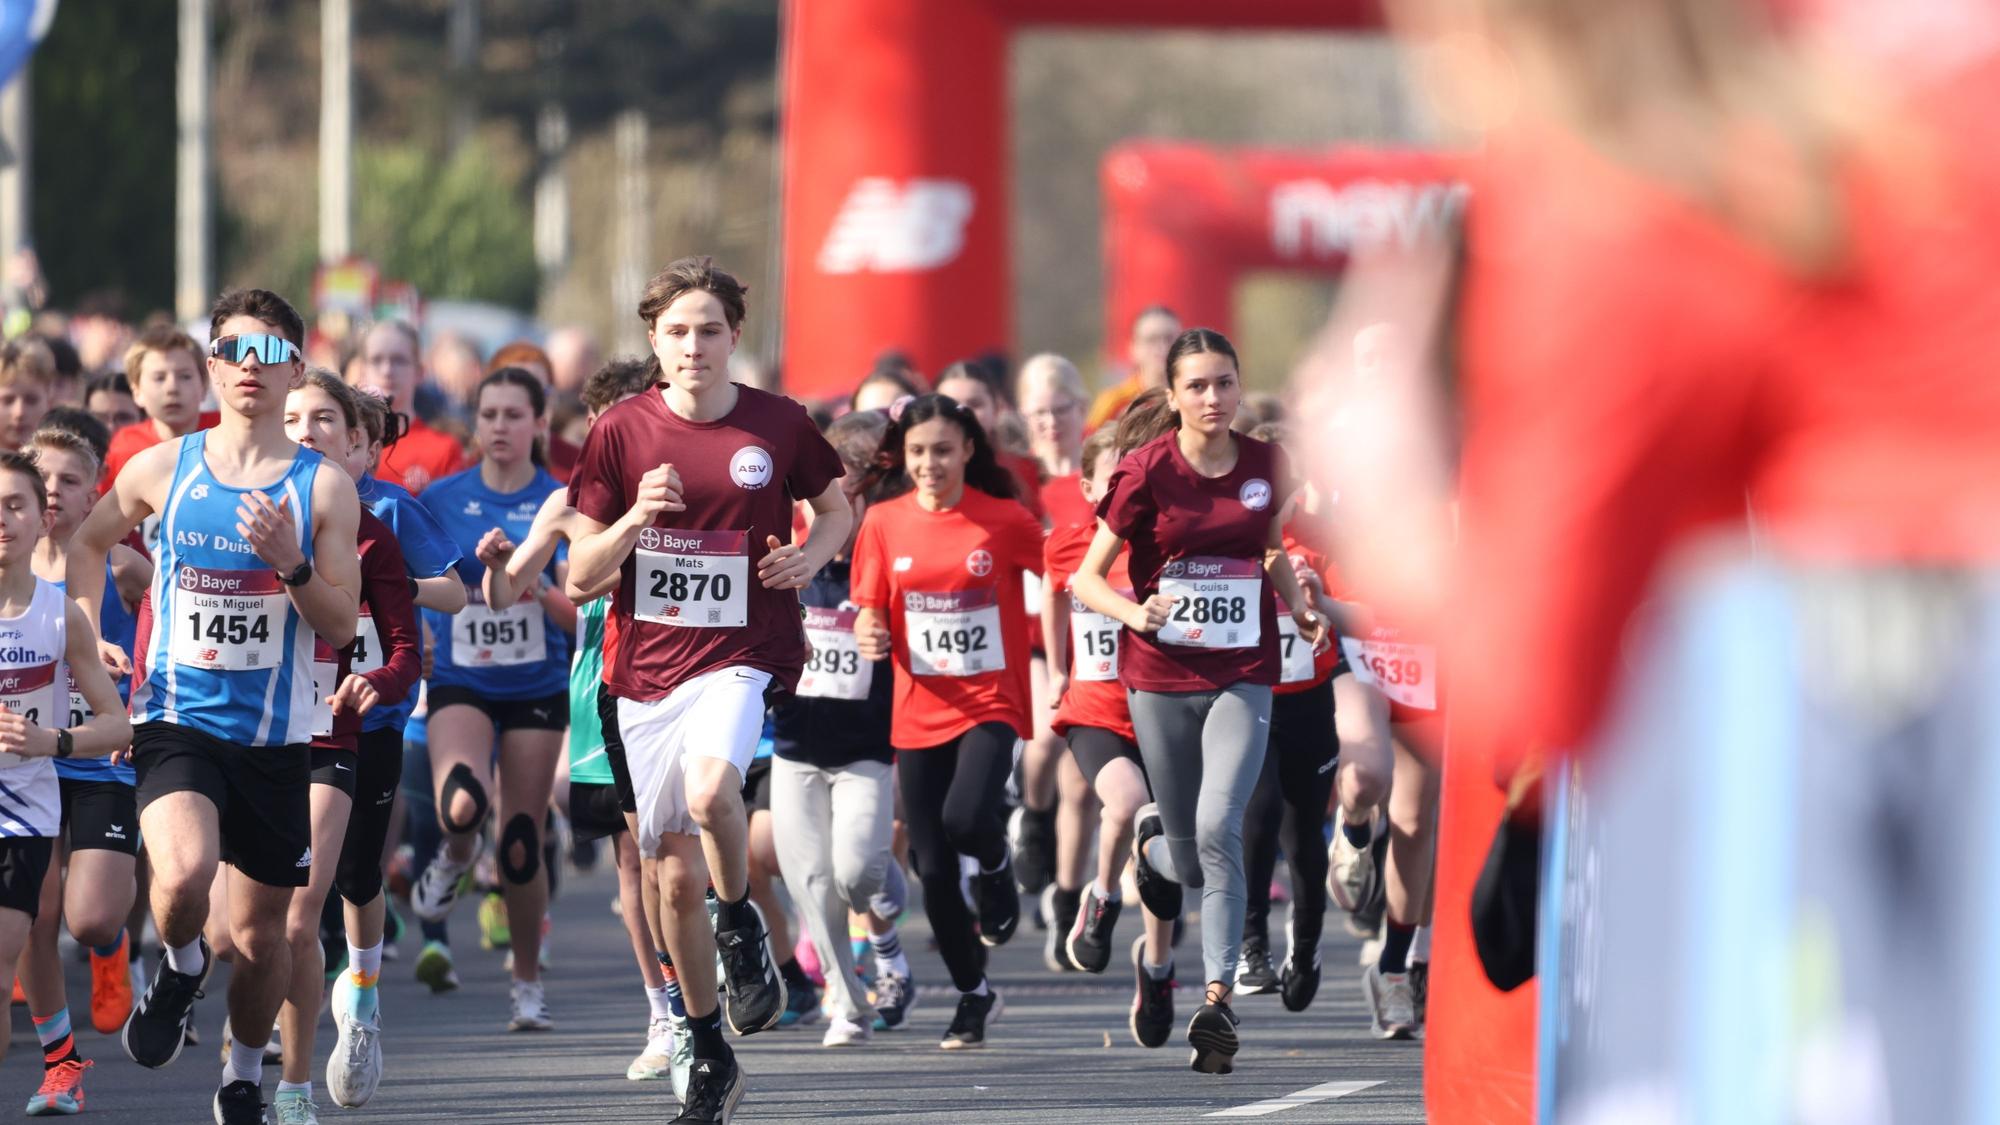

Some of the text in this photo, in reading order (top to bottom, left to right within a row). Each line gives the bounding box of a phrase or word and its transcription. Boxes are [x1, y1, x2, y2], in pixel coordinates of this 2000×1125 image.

[176, 531, 258, 554] ASV Duis
[663, 535, 702, 551] Bayer
[675, 558, 704, 568] Mats
[1188, 562, 1223, 577] Bayer
[201, 575, 242, 590] Bayer
[650, 569, 731, 601] 2870
[1193, 582, 1229, 592] Louisa
[194, 596, 264, 611] Luis Miguel
[926, 597, 960, 611] Bayer
[1173, 596, 1245, 624] 2868
[188, 612, 269, 645] 1454
[465, 618, 529, 645] 1951
[922, 626, 988, 655] 1492
[1083, 630, 1116, 656] 15
[1280, 633, 1296, 659] 7
[1357, 654, 1422, 686] 1639
